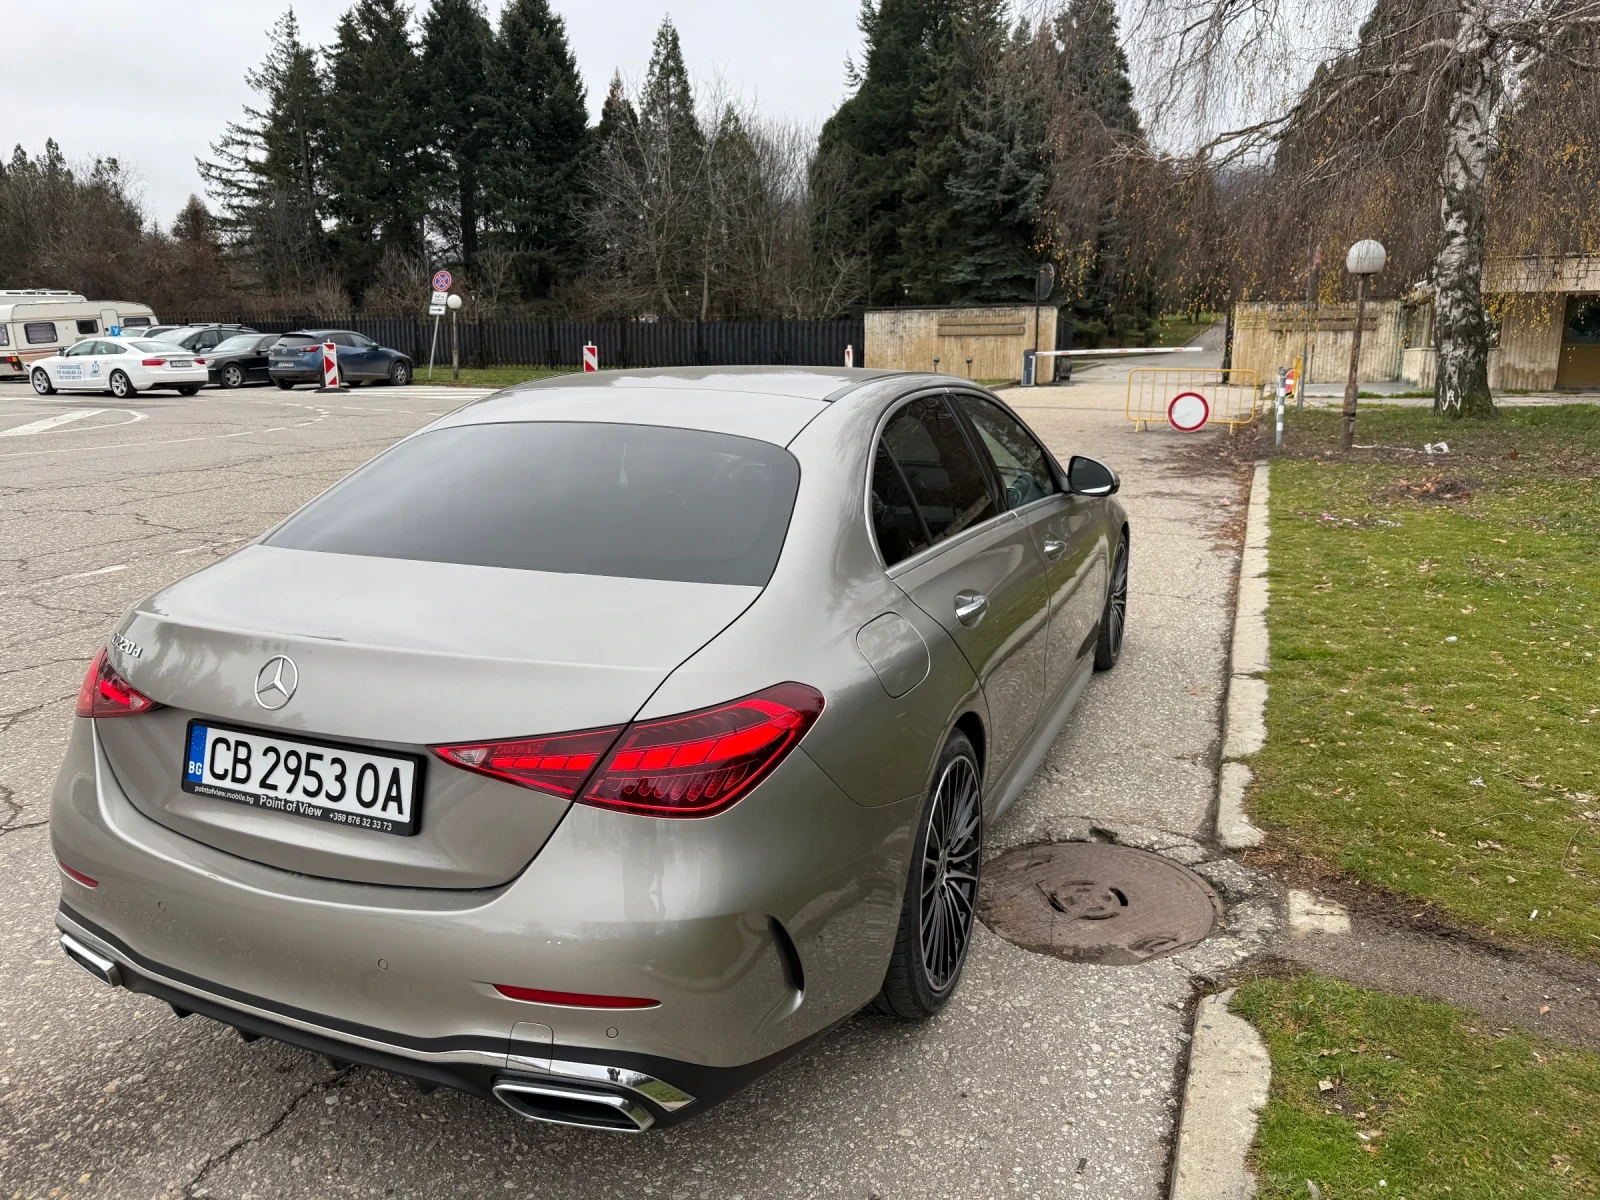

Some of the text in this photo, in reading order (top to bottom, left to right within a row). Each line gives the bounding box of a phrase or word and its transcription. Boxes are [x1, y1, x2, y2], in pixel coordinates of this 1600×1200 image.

[188, 761, 202, 775] BG
[209, 736, 404, 815] CB 2953 OA
[194, 785, 255, 804] pointofview.mobile.bg
[259, 794, 323, 817] Point of View
[329, 812, 393, 831] +359 876 32 33 73
